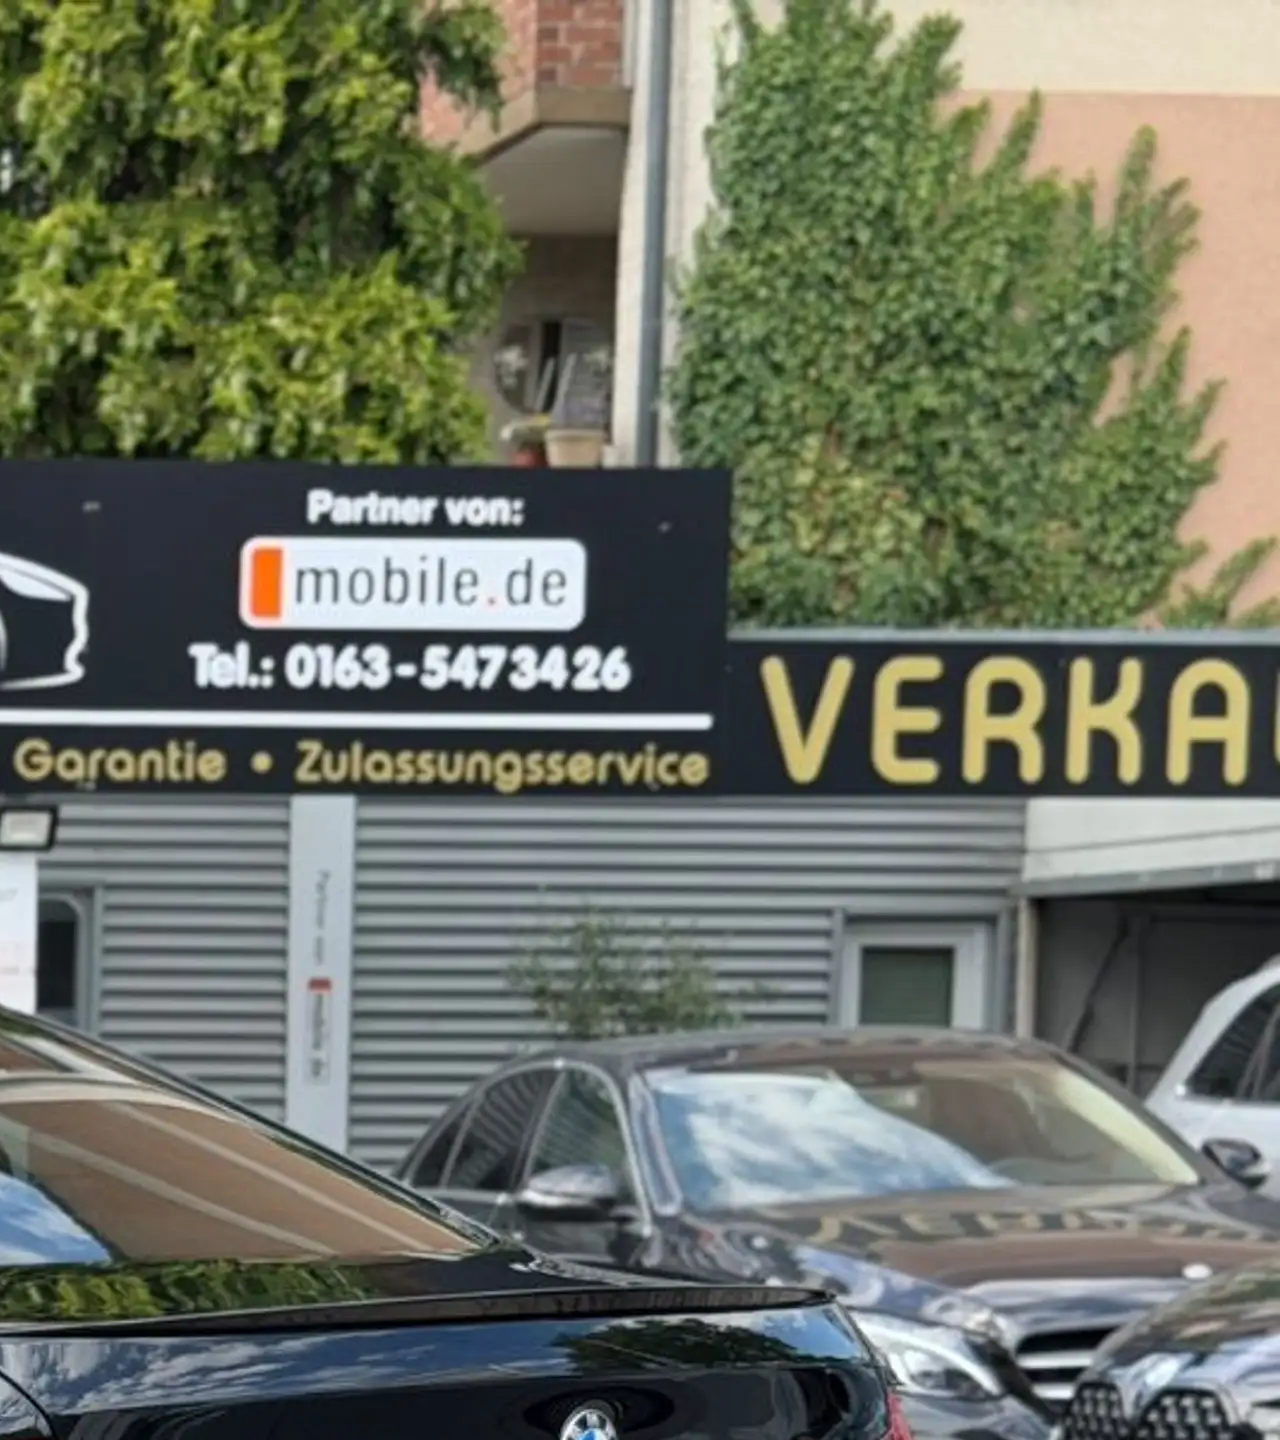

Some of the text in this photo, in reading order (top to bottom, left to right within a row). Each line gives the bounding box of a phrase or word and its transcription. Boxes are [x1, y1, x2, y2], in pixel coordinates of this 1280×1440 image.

[306, 488, 525, 526] Partner von:
[295, 556, 567, 606] mobile.de
[188, 641, 632, 692] Tel.: 0163-5473426
[760, 656, 1280, 786] VERKA
[13, 738, 227, 784] Garantie
[295, 740, 711, 793] Zulassungsservice
